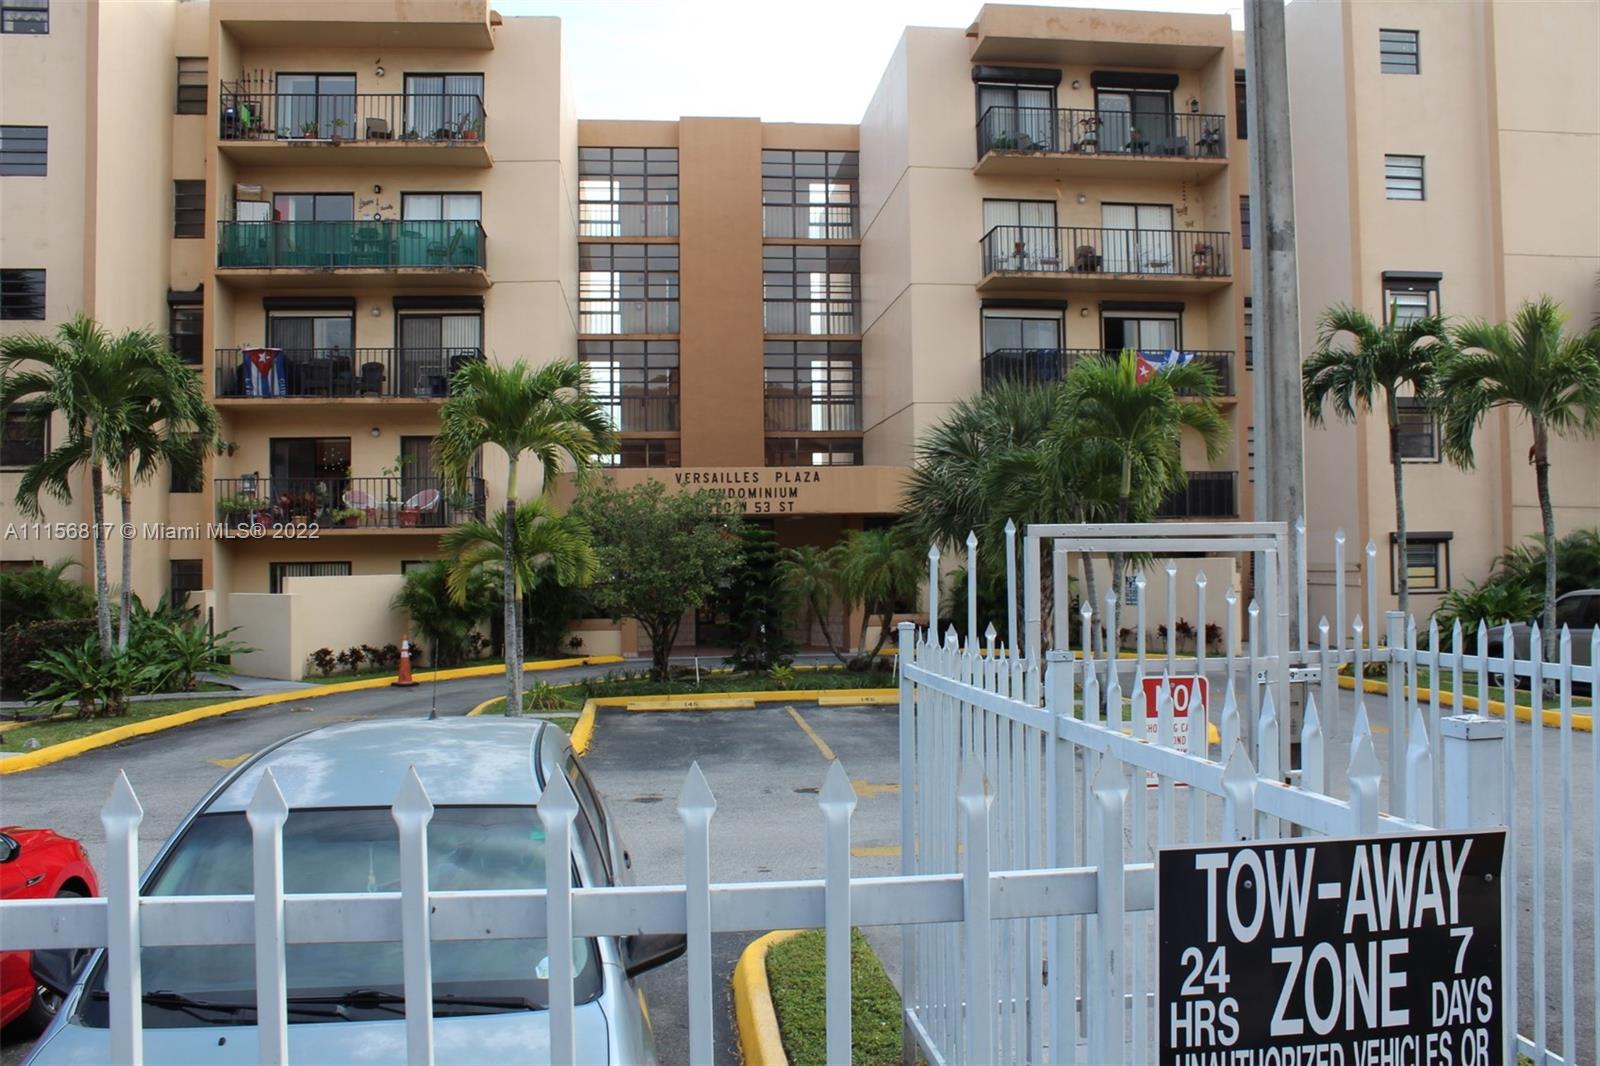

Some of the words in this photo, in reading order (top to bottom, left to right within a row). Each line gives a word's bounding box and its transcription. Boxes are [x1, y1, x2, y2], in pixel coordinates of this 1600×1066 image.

[675, 472, 759, 484] VERSAILLES
[775, 471, 821, 483] PLAZA
[755, 501, 770, 513] 53
[779, 501, 794, 512] ST
[1156, 684, 1189, 711] O
[1195, 839, 1474, 943] TOW-AWAY
[1180, 946, 1230, 996] 24
[1450, 927, 1474, 974] 7
[1270, 938, 1410, 1037] ZONE
[1432, 976, 1493, 1027] DAYS
[1171, 997, 1240, 1049] HRS
[1353, 1030, 1453, 1066] VEHICLES
[1461, 1027, 1490, 1066] OR
